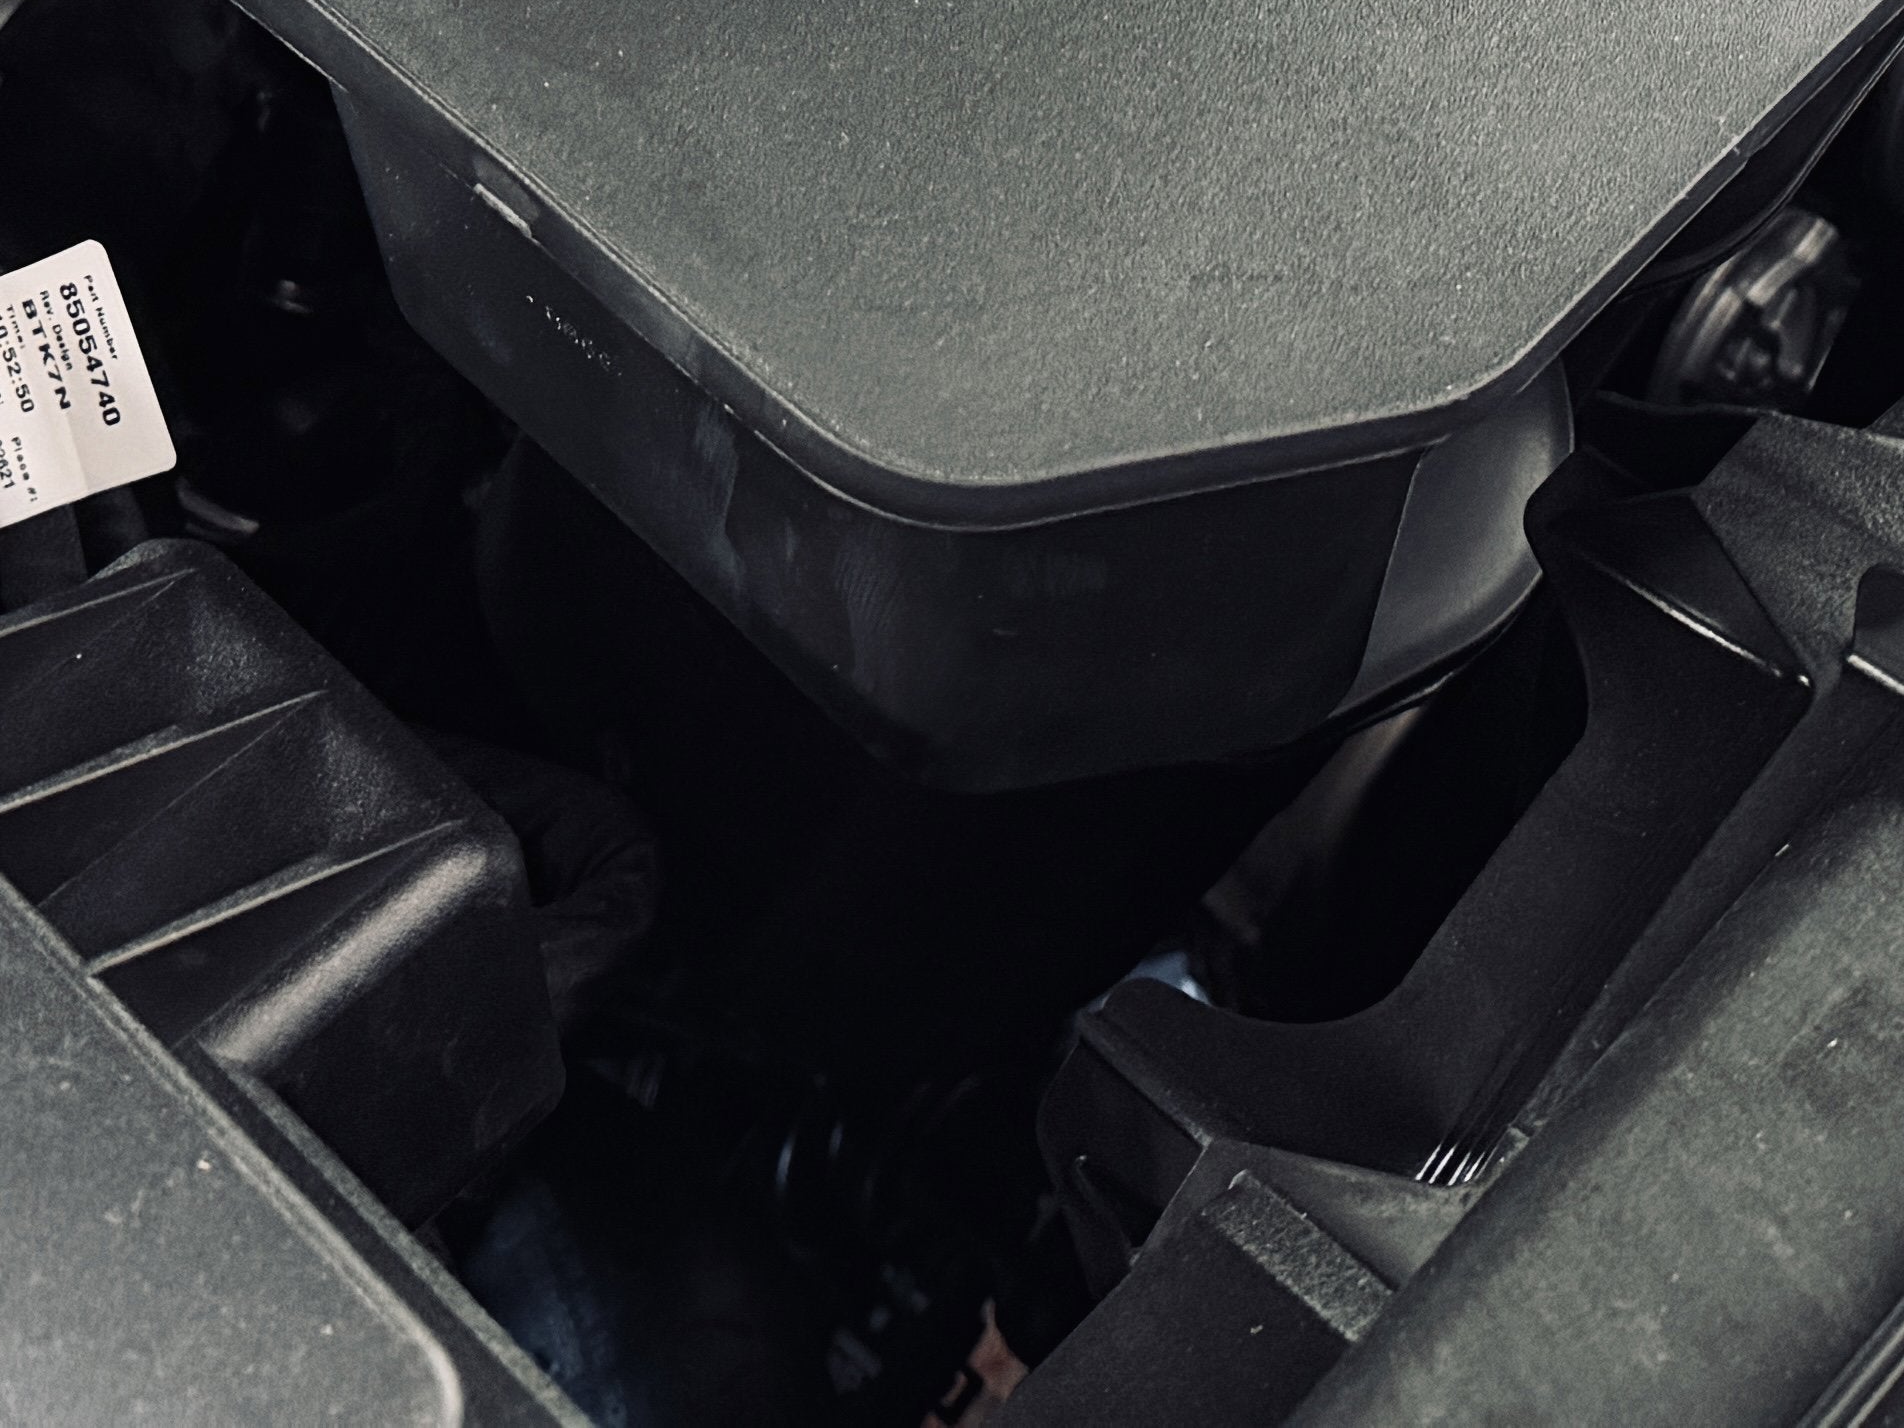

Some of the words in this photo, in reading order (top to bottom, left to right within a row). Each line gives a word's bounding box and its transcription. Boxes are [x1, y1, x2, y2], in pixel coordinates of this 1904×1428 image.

[21, 299, 71, 410] BTK7N
[52, 323, 73, 371] Design
[59, 282, 121, 426] 85054740
[83, 274, 99, 302] Part
[96, 307, 118, 360] Number
